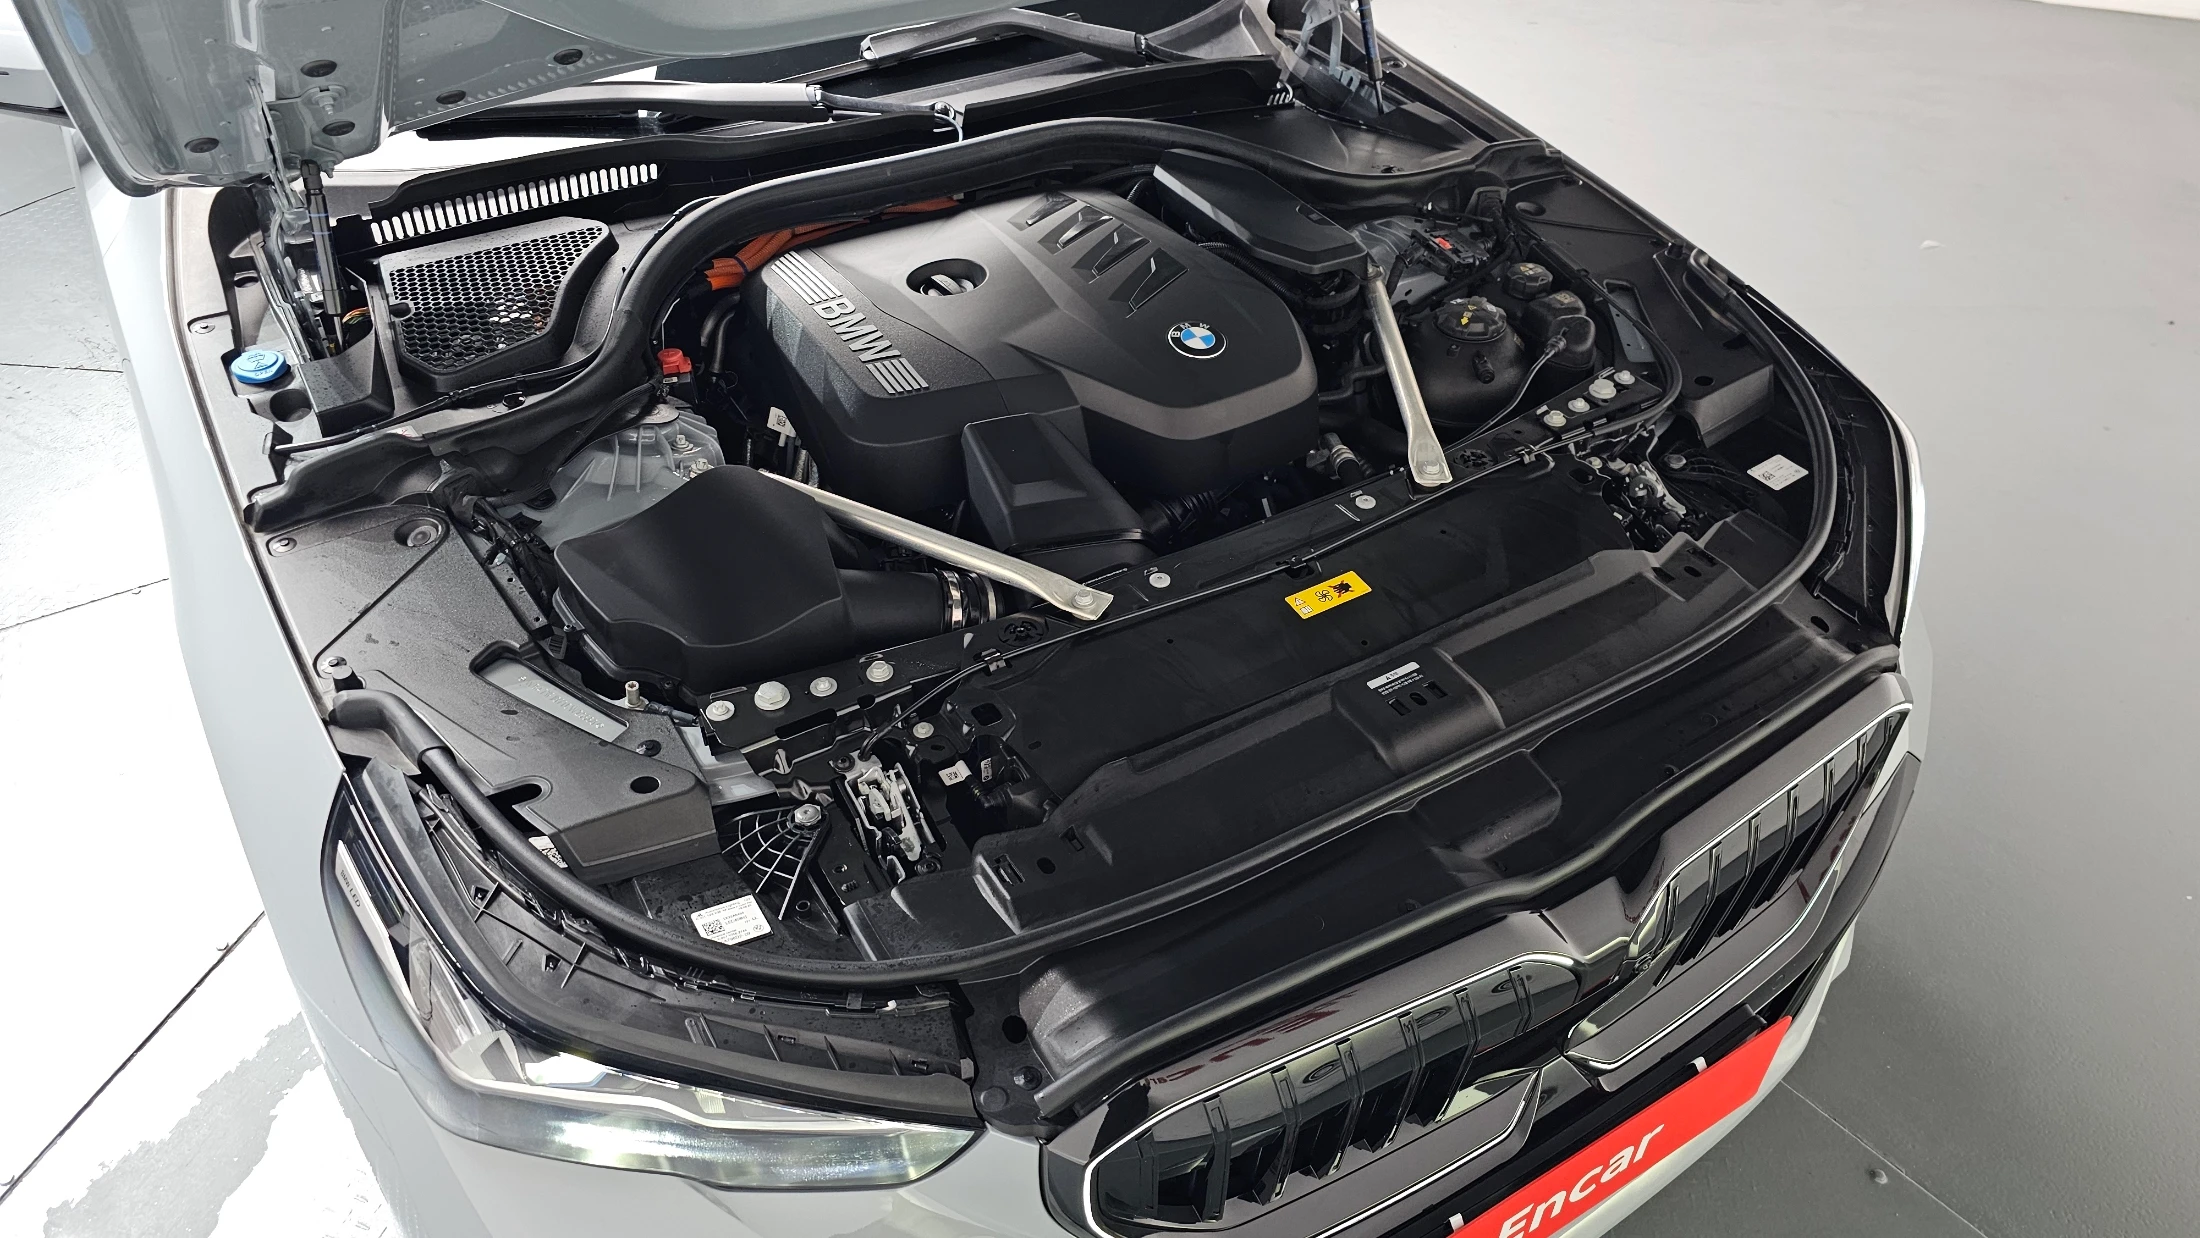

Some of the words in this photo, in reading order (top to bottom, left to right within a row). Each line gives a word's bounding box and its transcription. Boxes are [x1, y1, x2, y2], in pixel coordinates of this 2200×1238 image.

[812, 297, 901, 363] BMW
[1171, 322, 1211, 338] BMW
[349, 887, 361, 908] LED
[1498, 1123, 1665, 1238] Encar
